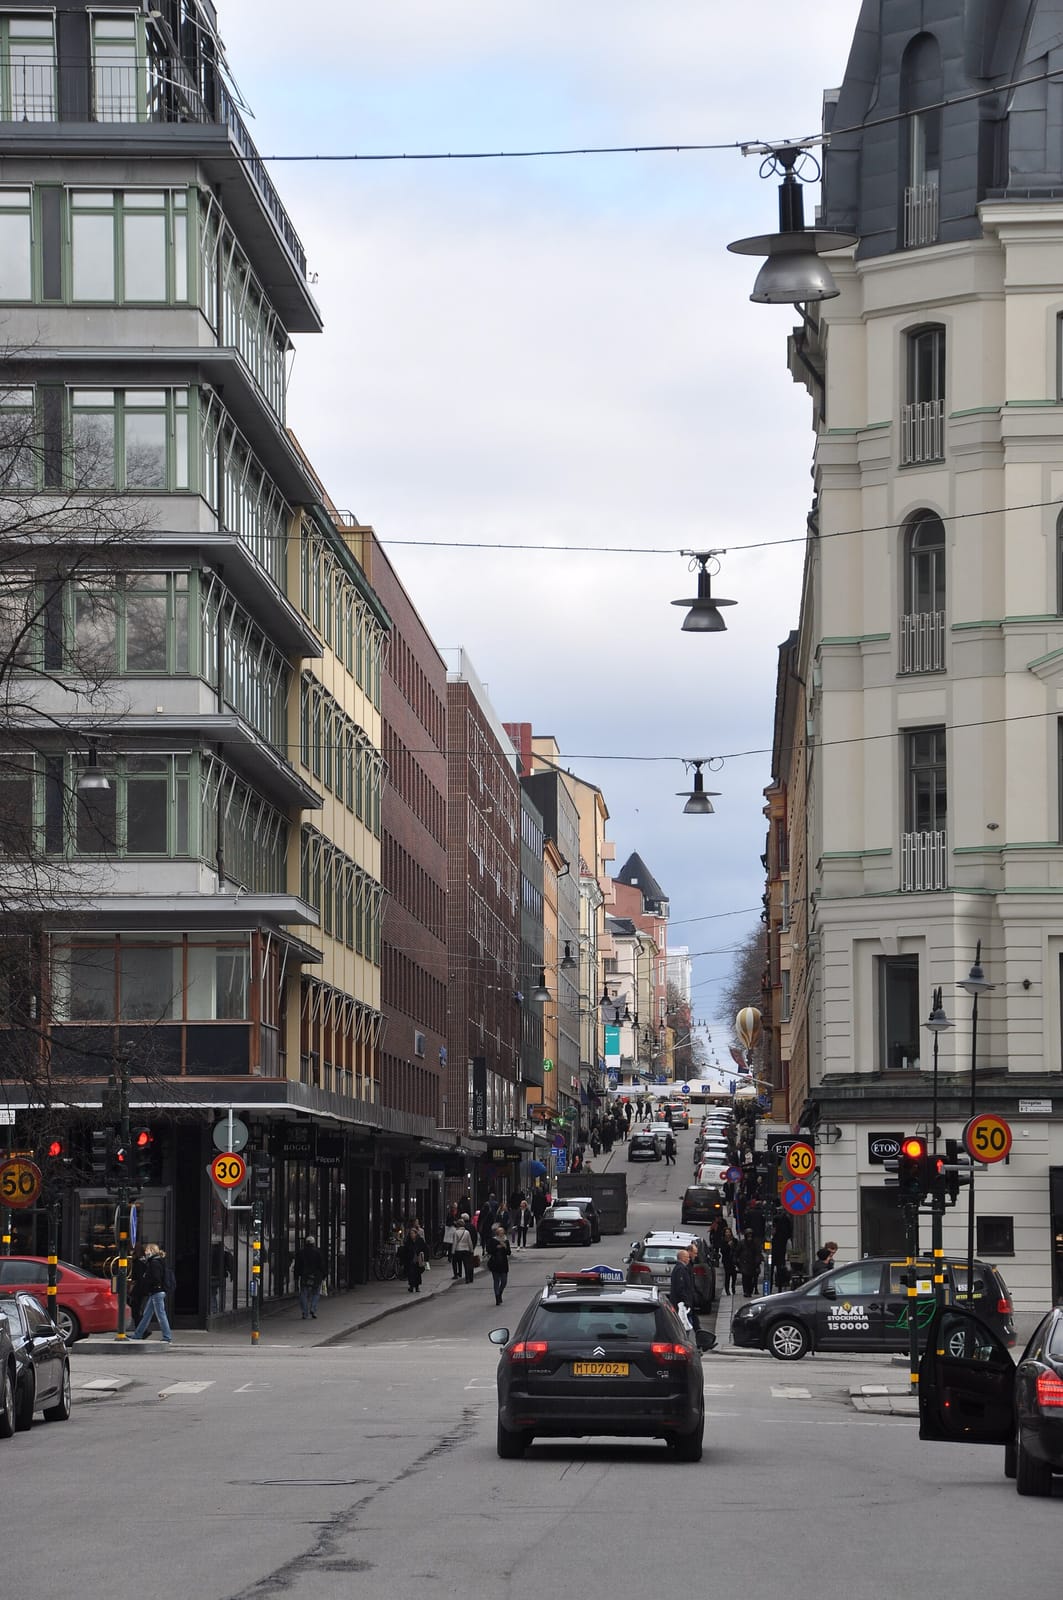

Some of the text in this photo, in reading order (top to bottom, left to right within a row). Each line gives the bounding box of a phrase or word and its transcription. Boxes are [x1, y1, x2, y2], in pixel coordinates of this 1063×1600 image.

[873, 1143, 898, 1153] ETON
[976, 1127, 1006, 1151] 50
[775, 1145, 789, 1154] ET
[791, 1151, 811, 1170] 30
[217, 1161, 241, 1179] 30
[2, 1171, 35, 1196] 50
[830, 1305, 864, 1316] TAXI
